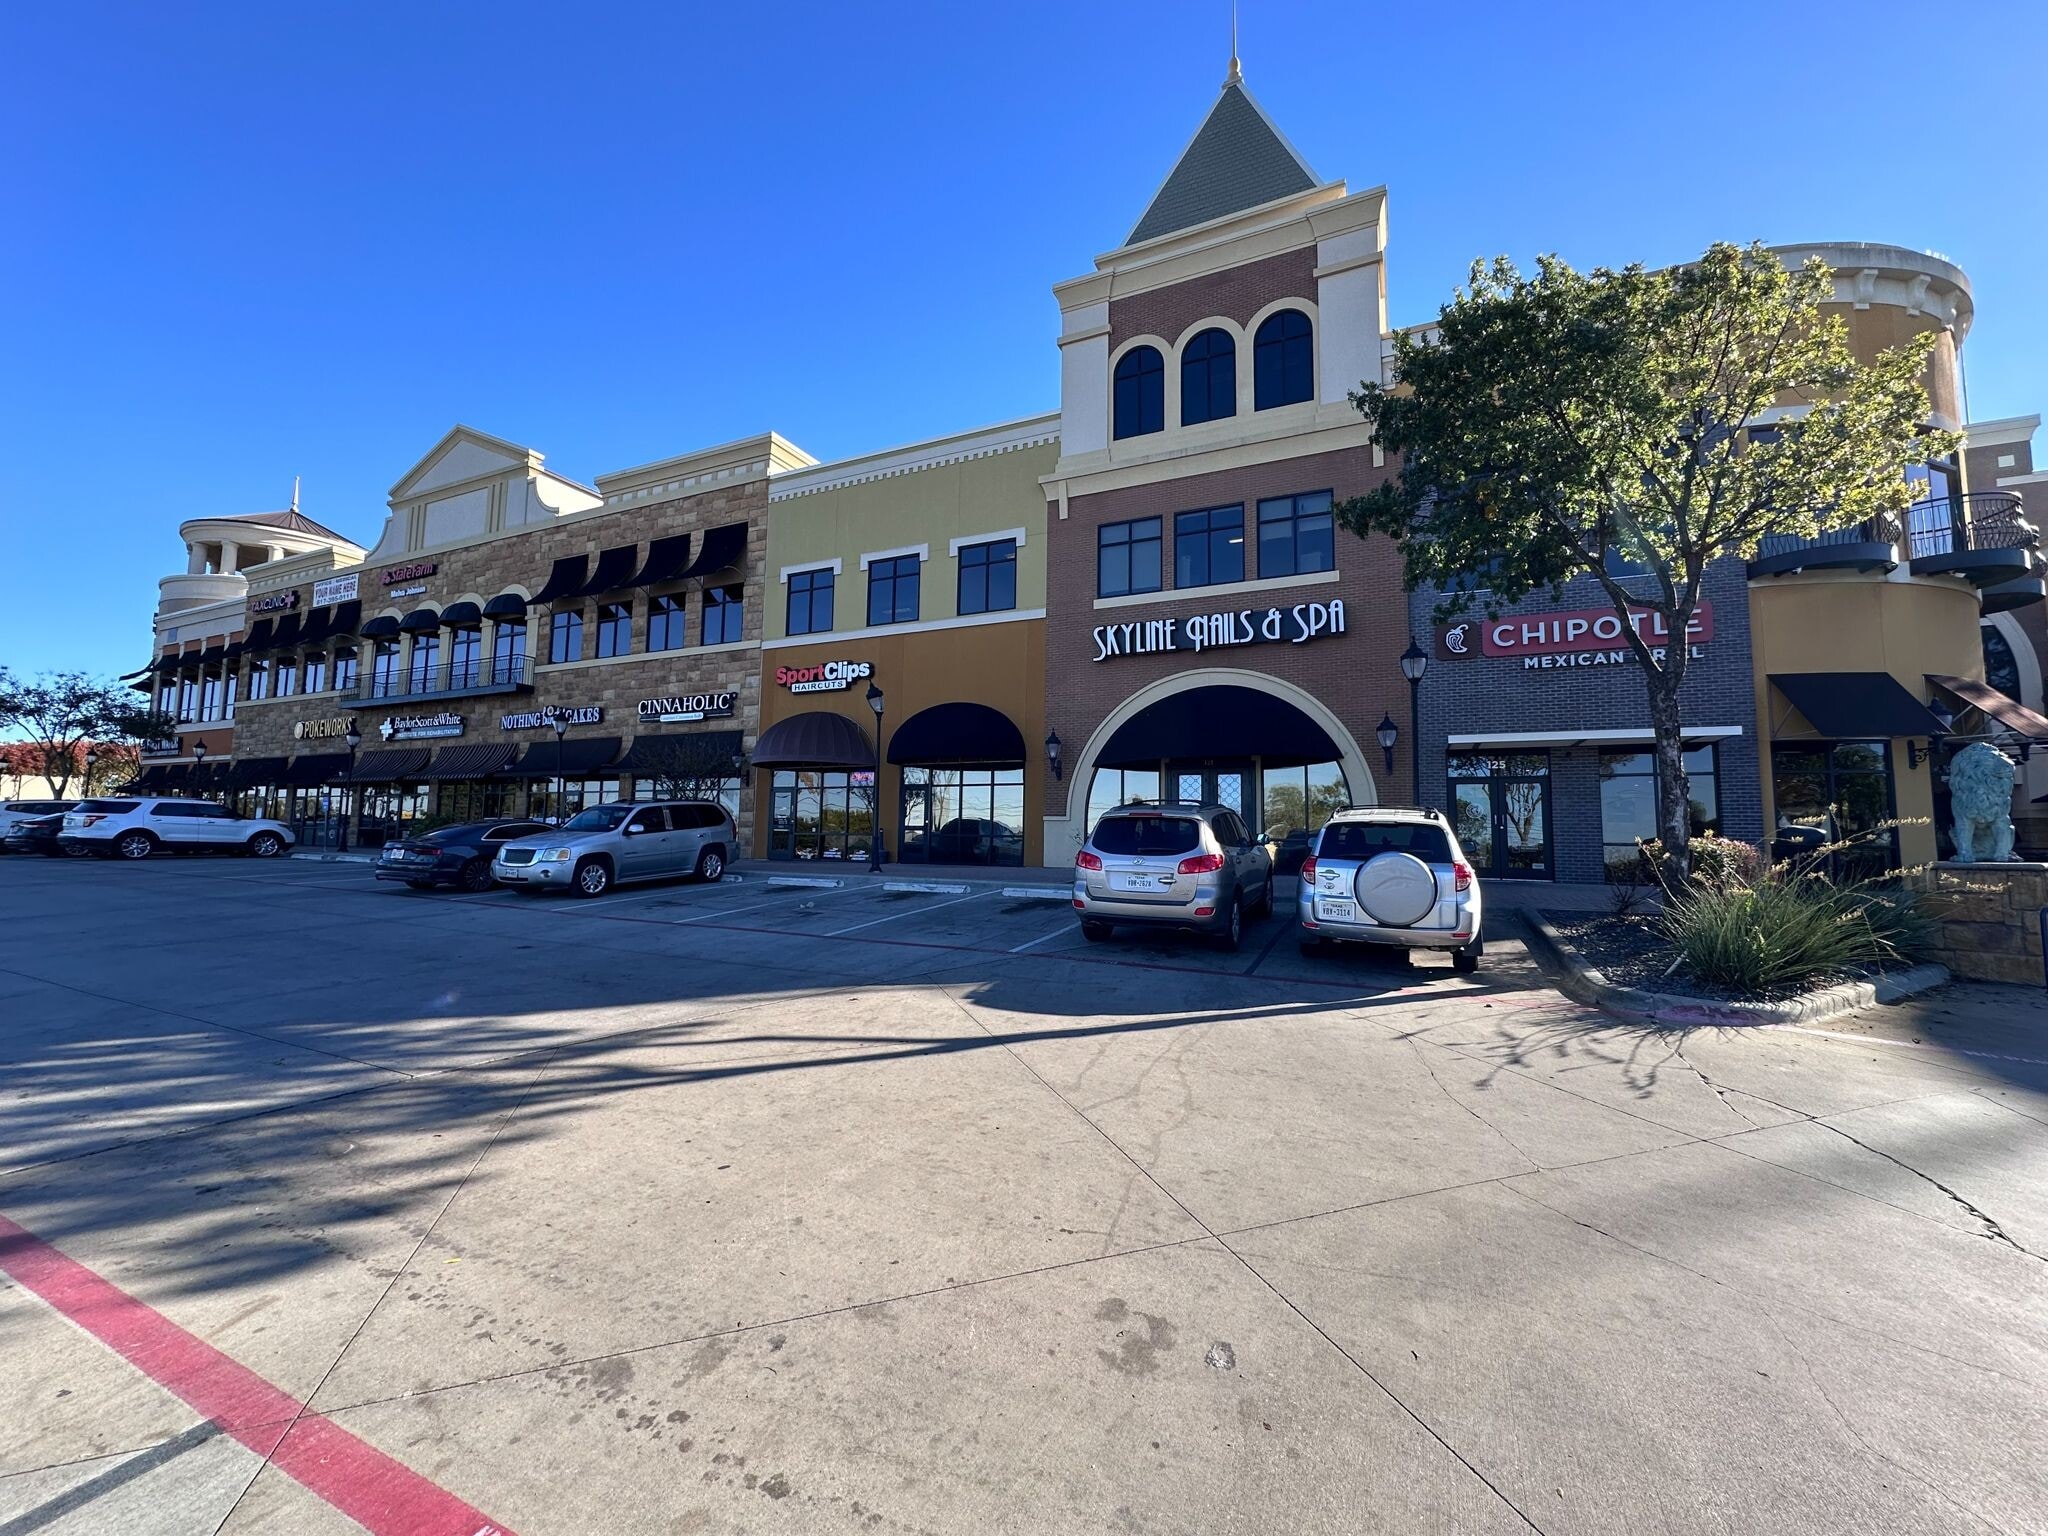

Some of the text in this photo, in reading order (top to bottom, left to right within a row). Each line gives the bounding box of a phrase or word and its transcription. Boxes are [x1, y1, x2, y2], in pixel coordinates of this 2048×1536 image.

[1092, 599, 1345, 662] SKYLINE NAILS & SPA
[1523, 650, 1624, 669] MEXICAN
[794, 680, 843, 692] HAIRCUTS
[638, 693, 730, 715] CINNAHOLIC
[304, 717, 353, 738] POKEWORKS
[501, 712, 540, 729] NOTHING
[565, 707, 600, 724] CAKES
[1486, 760, 1506, 769] 125
